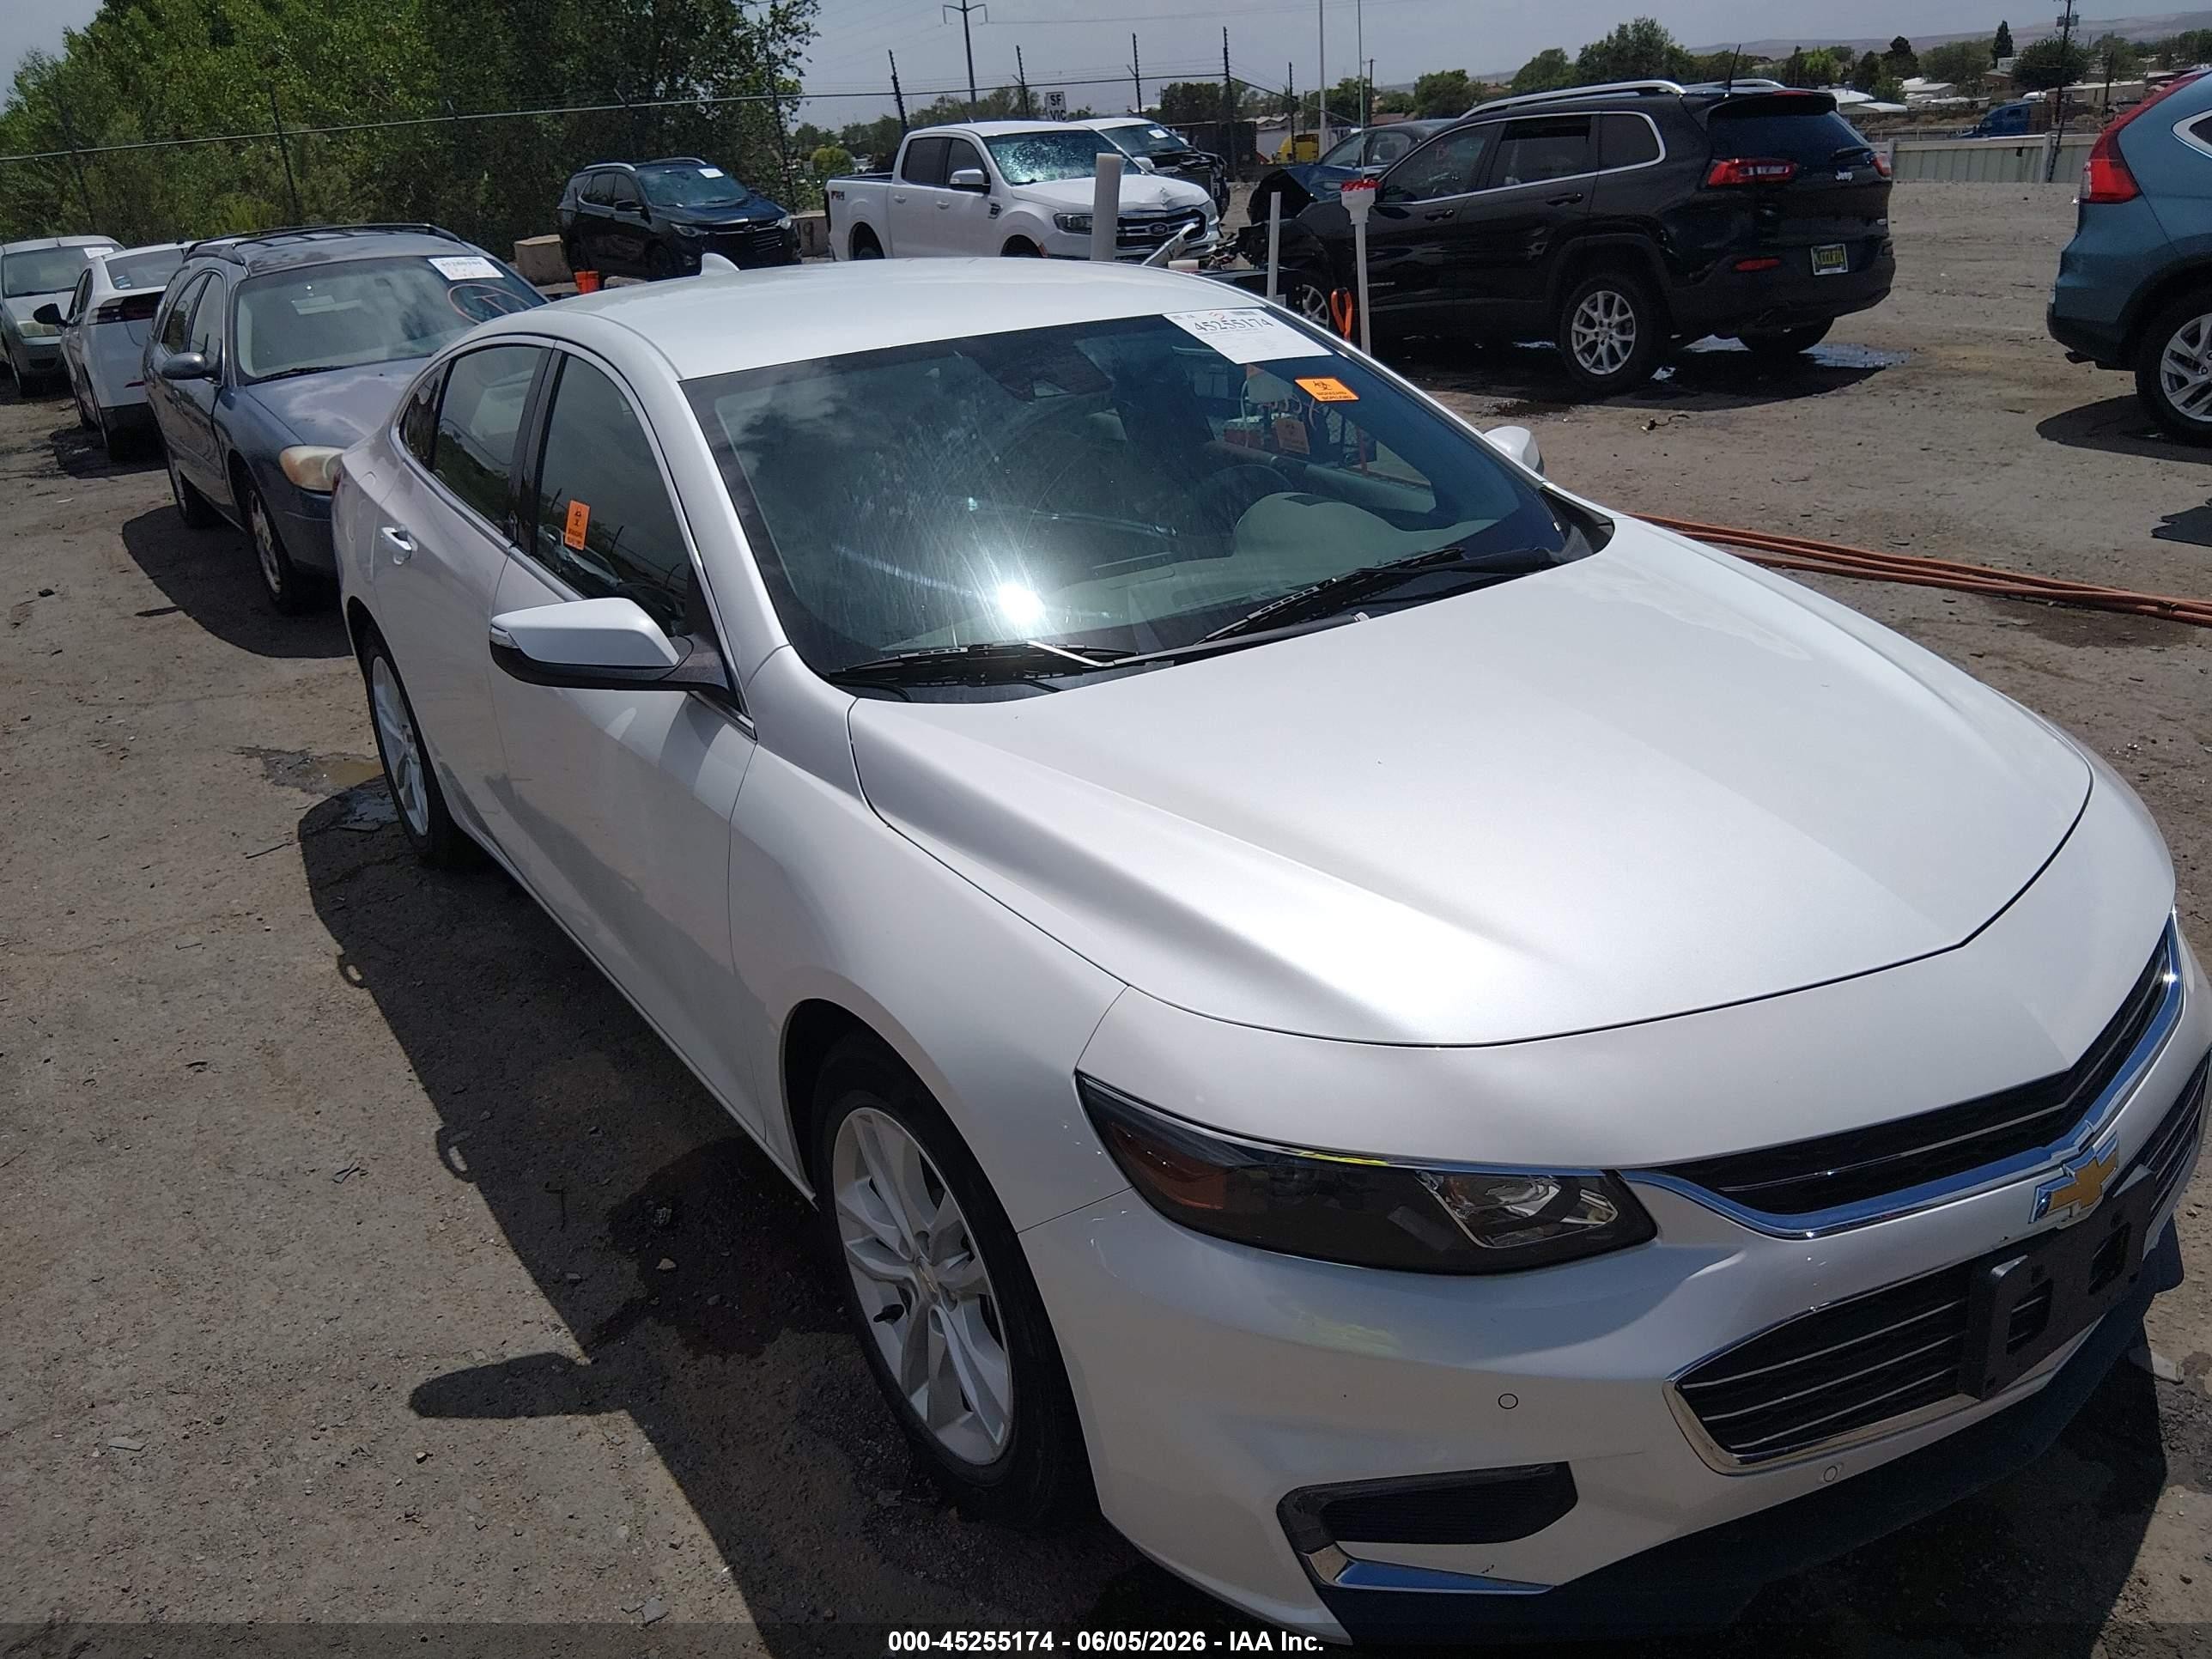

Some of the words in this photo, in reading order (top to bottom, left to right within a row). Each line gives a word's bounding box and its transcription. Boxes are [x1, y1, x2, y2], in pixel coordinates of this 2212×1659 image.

[1050, 94, 1061, 106] SF
[1835, 170, 1853, 182] Jeep
[1194, 319, 1274, 331] 45255174
